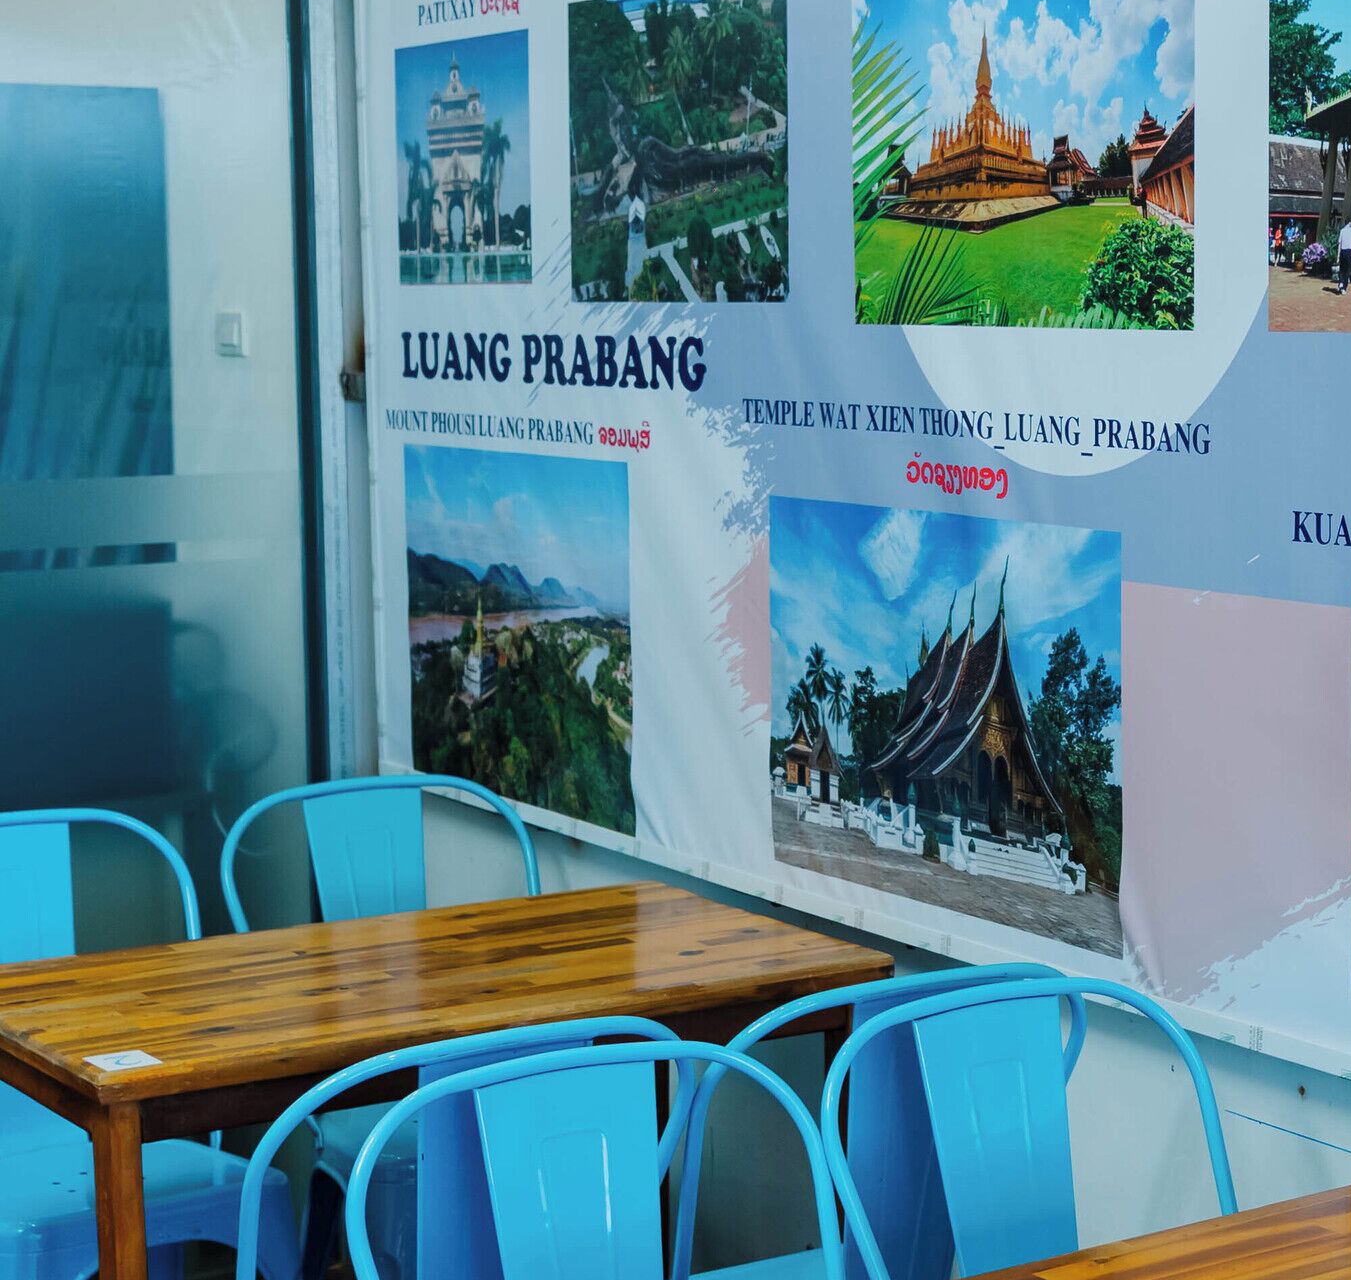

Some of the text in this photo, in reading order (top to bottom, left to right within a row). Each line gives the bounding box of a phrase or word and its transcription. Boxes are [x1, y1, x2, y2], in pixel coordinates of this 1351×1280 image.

[401, 331, 707, 392] LUANG PRABANG
[385, 408, 428, 433] MOUNT
[431, 410, 476, 436] PHOUSI
[478, 414, 524, 440] LUANG
[528, 418, 594, 445] PRABANG
[742, 397, 815, 428] TEMPLE
[819, 402, 862, 431] WAT
[865, 404, 916, 435] XIEN
